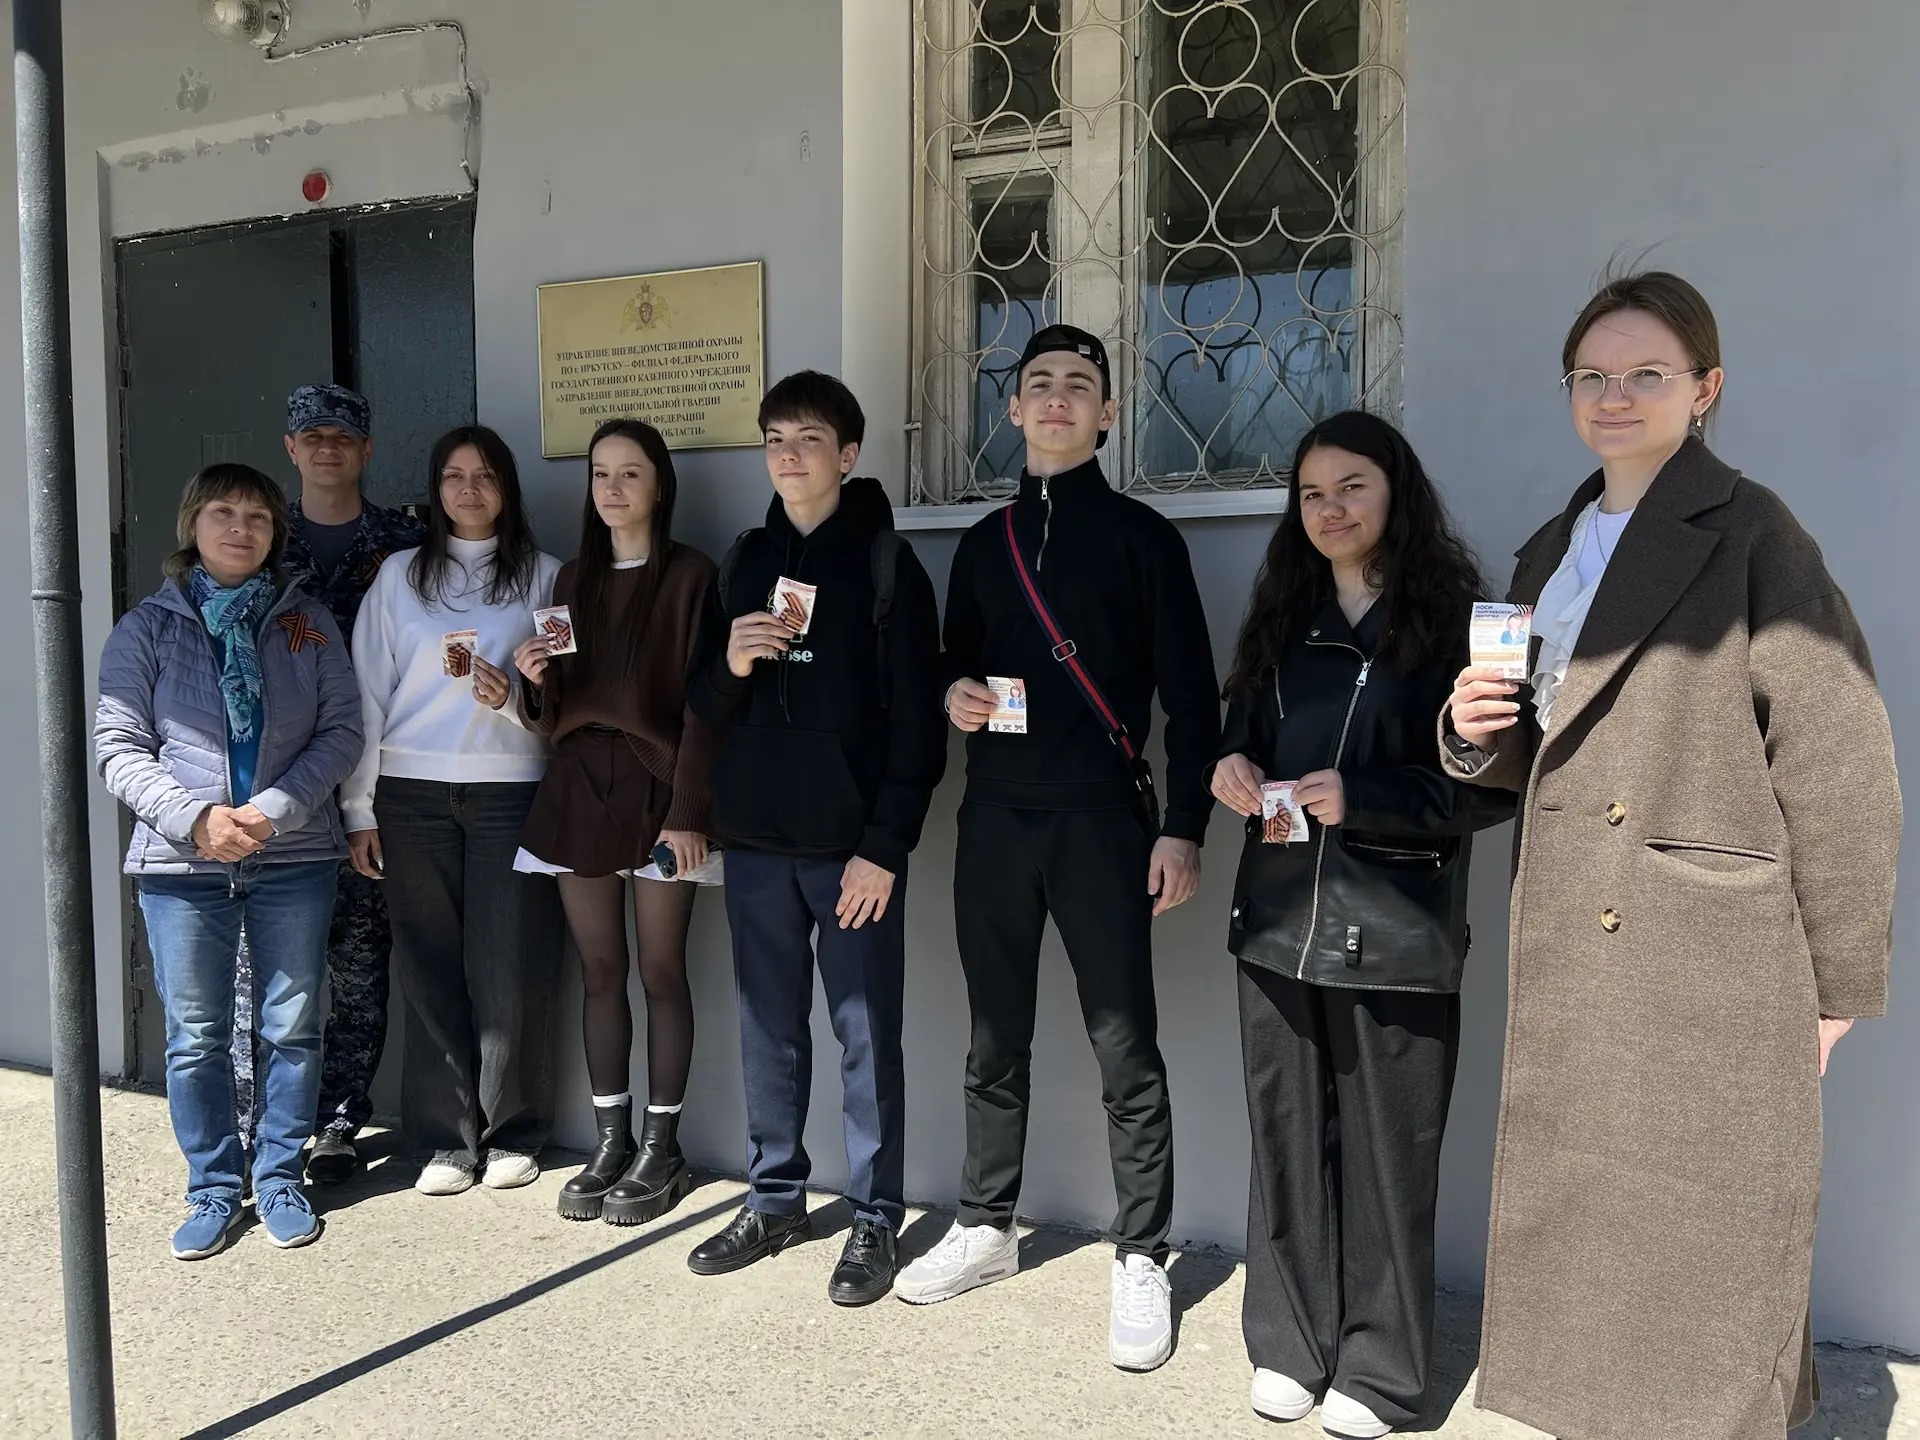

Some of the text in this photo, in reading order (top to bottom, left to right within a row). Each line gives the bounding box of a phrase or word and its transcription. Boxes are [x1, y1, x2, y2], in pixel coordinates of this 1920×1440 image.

[557, 336, 743, 361] УПРАВЛЕНИЕ ВНЕВЕДОМСТВЕННОЙ ОХРАНЫ
[561, 366, 573, 375] ПО
[580, 360, 623, 373] ИРКУТСКУ
[631, 356, 668, 368] ФИЛИАЛ
[669, 351, 739, 365] ФЕДЕРАЛЬНОГО
[551, 365, 751, 389] ГОСУДАРСТВЕННОГО КАЗЕННОГО УЧРЕЖДЕНИЯ
[556, 380, 745, 403] «УПРАВЛЕНИЕ ВНЕВЕДОМСТВЕННОЙ ОХРАНЫ
[579, 396, 721, 415] ВОЙСК НАЦИОНАЛЬНОЙ ГВАРДИИ
[653, 412, 705, 424] ФЕДЕРАЦИИ
[661, 426, 706, 437] ОБЛАСТИ»
